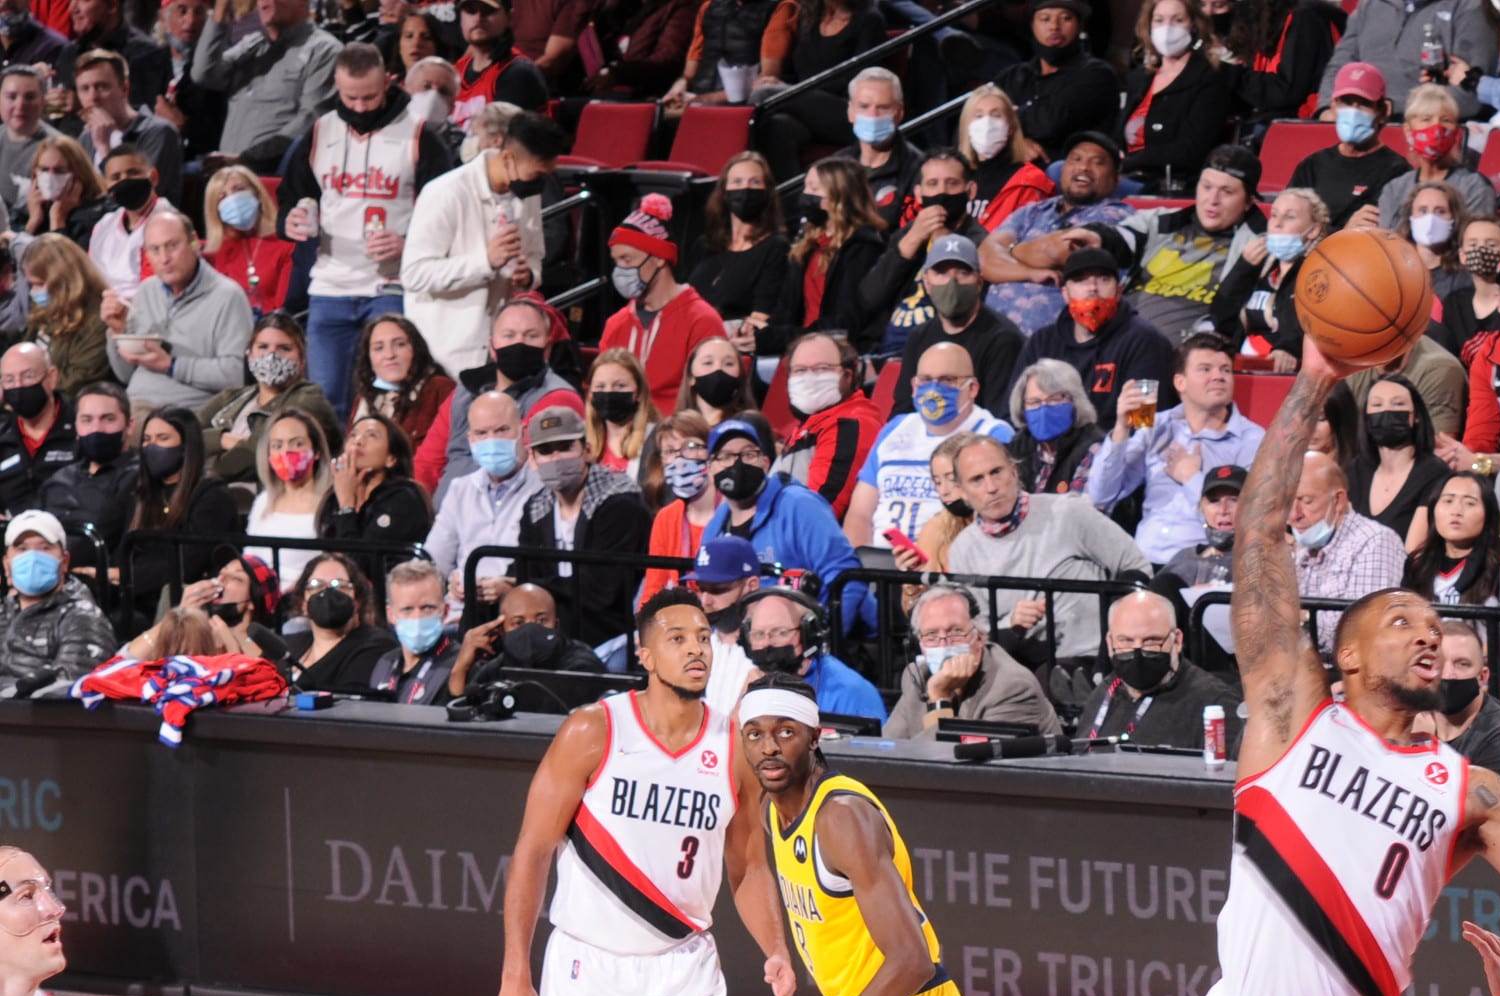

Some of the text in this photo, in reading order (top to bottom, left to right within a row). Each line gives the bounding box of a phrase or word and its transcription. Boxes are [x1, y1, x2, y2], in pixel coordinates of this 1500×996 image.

[322, 166, 400, 200] ripcity
[611, 776, 721, 831] BLAZERS
[1299, 743, 1447, 853] BLAZERS
[324, 838, 514, 915] DAIM
[676, 835, 700, 880] 3
[914, 847, 1227, 924] THE FUTURE
[1373, 841, 1410, 901] 0
